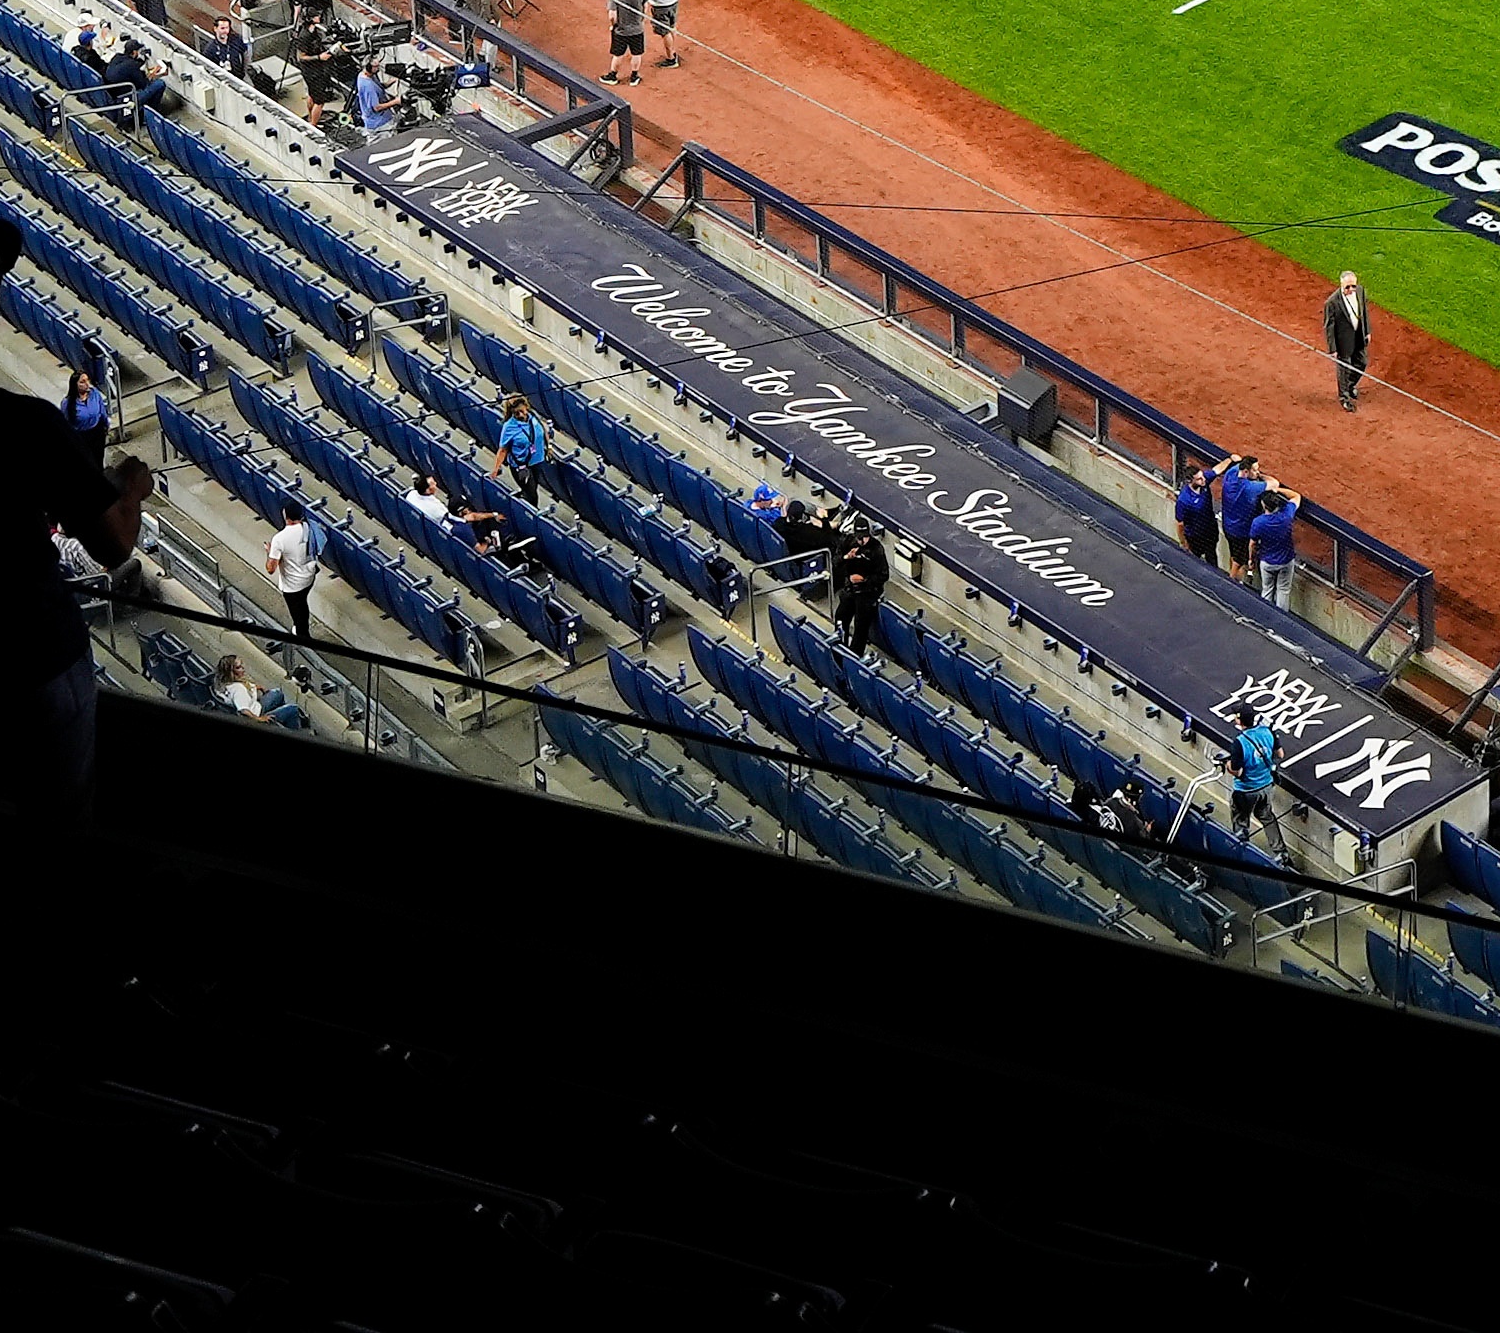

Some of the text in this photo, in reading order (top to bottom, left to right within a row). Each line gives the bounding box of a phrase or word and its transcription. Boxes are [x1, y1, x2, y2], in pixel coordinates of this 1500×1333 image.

[591, 263, 1115, 608] Welcome to Yankee Stadium
